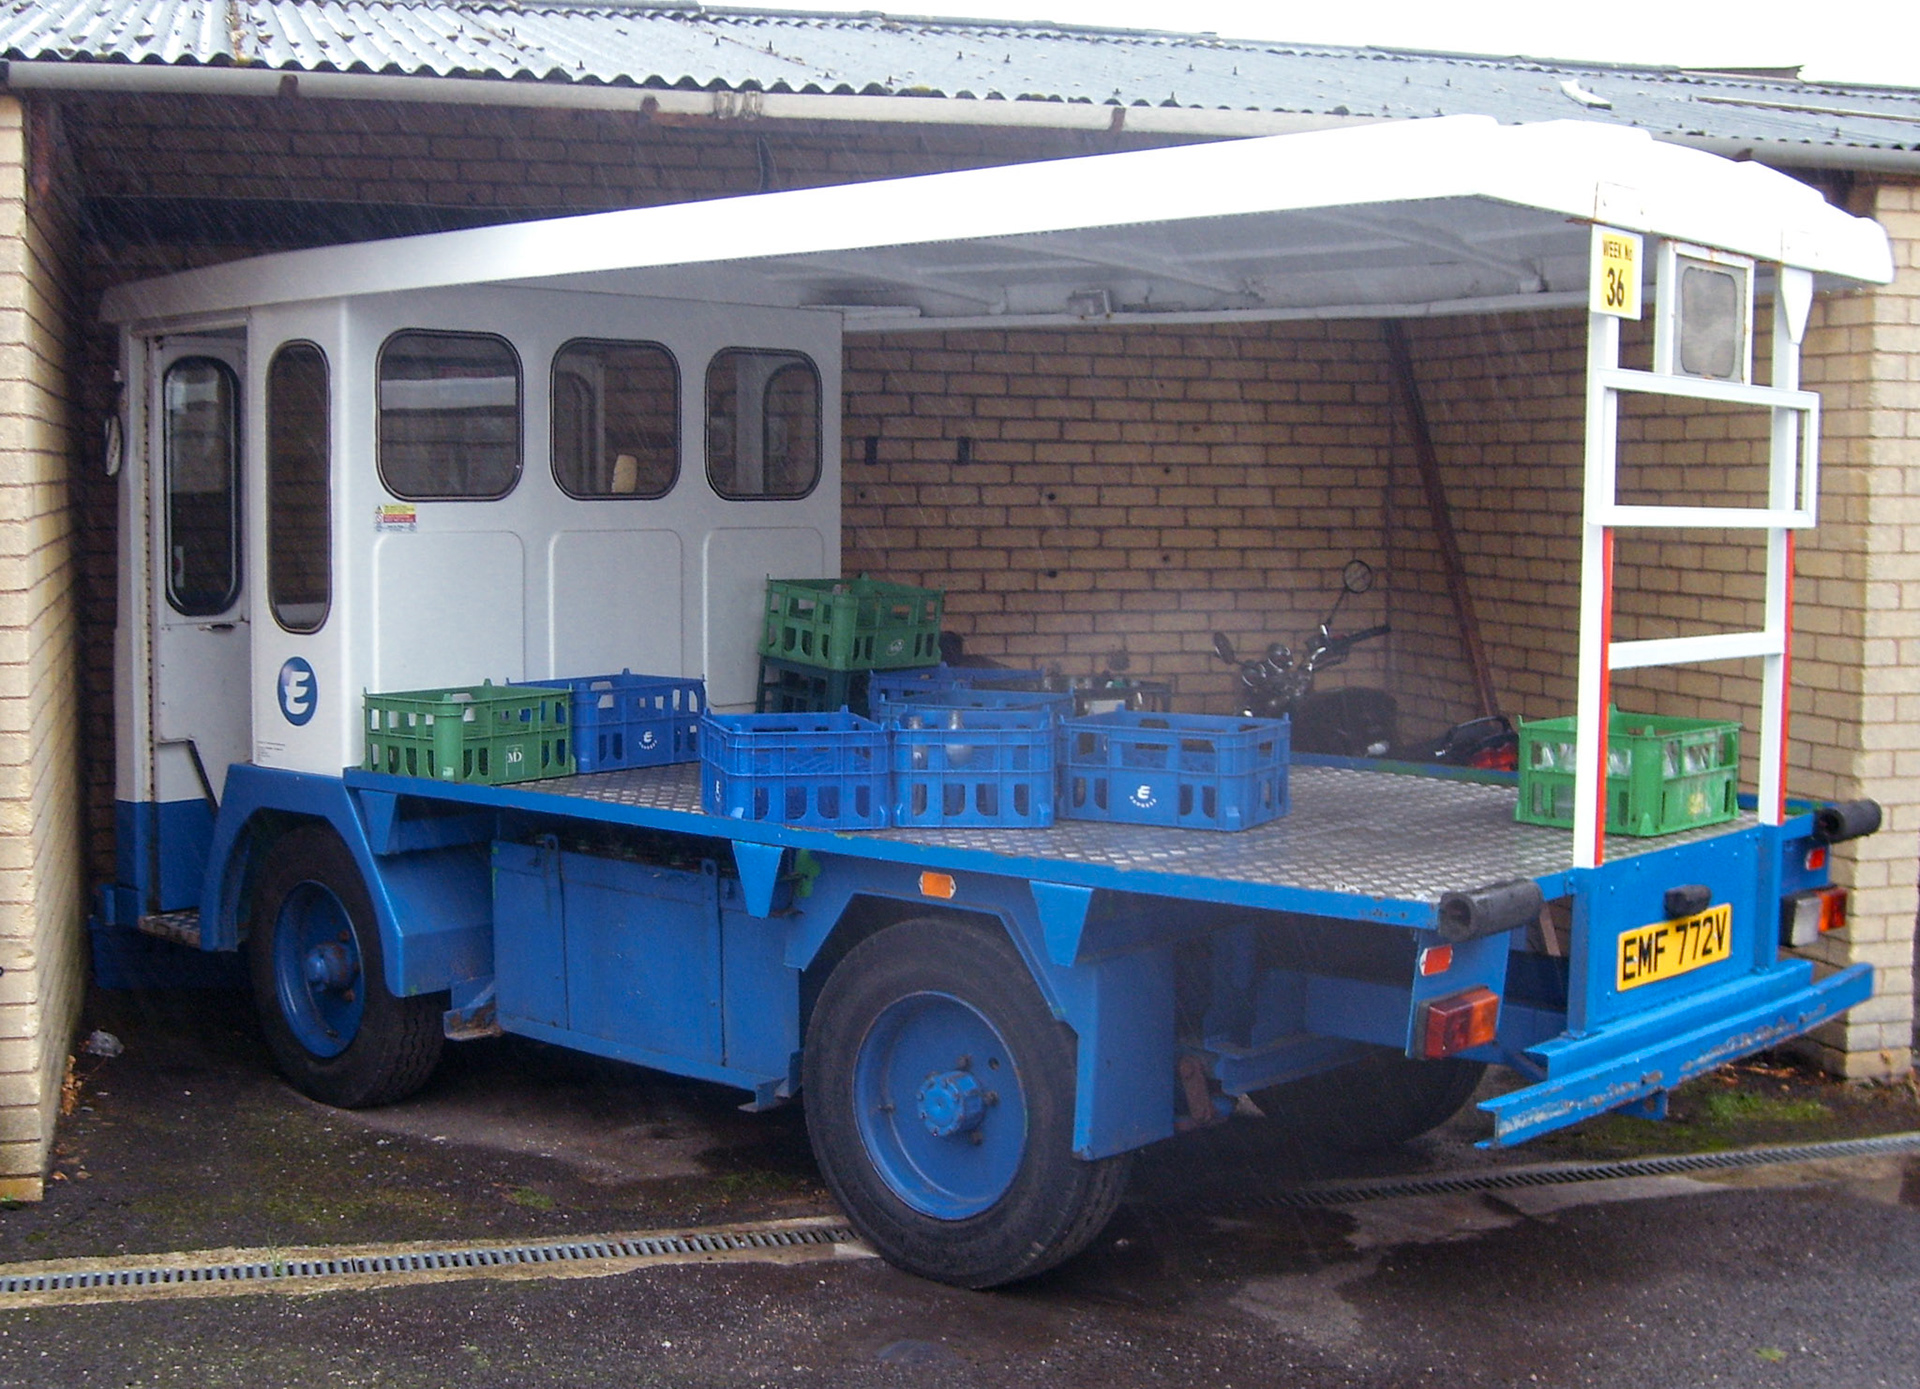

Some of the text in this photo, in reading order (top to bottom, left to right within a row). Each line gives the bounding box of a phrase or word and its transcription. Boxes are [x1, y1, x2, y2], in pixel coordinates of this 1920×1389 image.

[1603, 240, 1621, 259] WEEK
[1606, 266, 1625, 308] 36
[283, 670, 310, 715] E
[1622, 910, 1728, 981] EMF 772V
